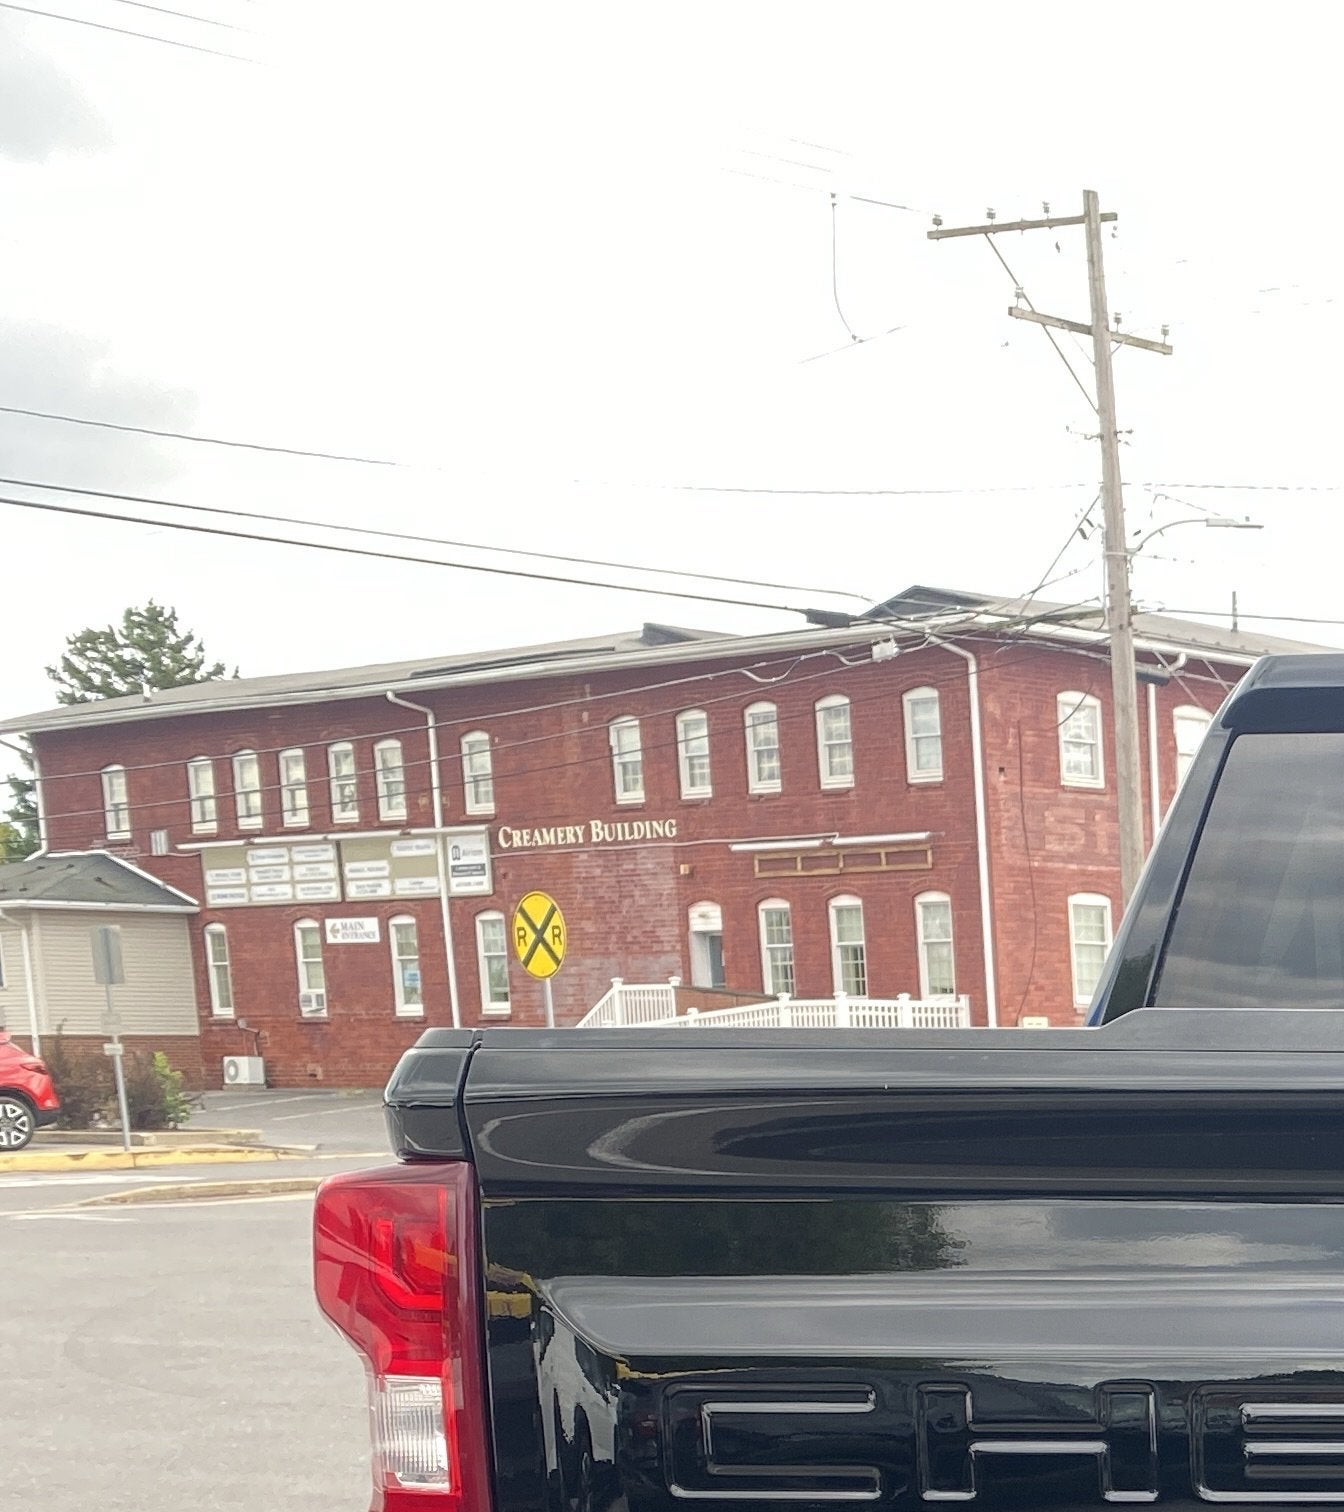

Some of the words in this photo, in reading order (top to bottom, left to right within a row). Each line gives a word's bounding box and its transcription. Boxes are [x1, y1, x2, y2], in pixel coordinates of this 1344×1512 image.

[498, 825, 586, 848] CREAMERY
[589, 818, 678, 842] BUILDING
[340, 920, 365, 931] MAIN
